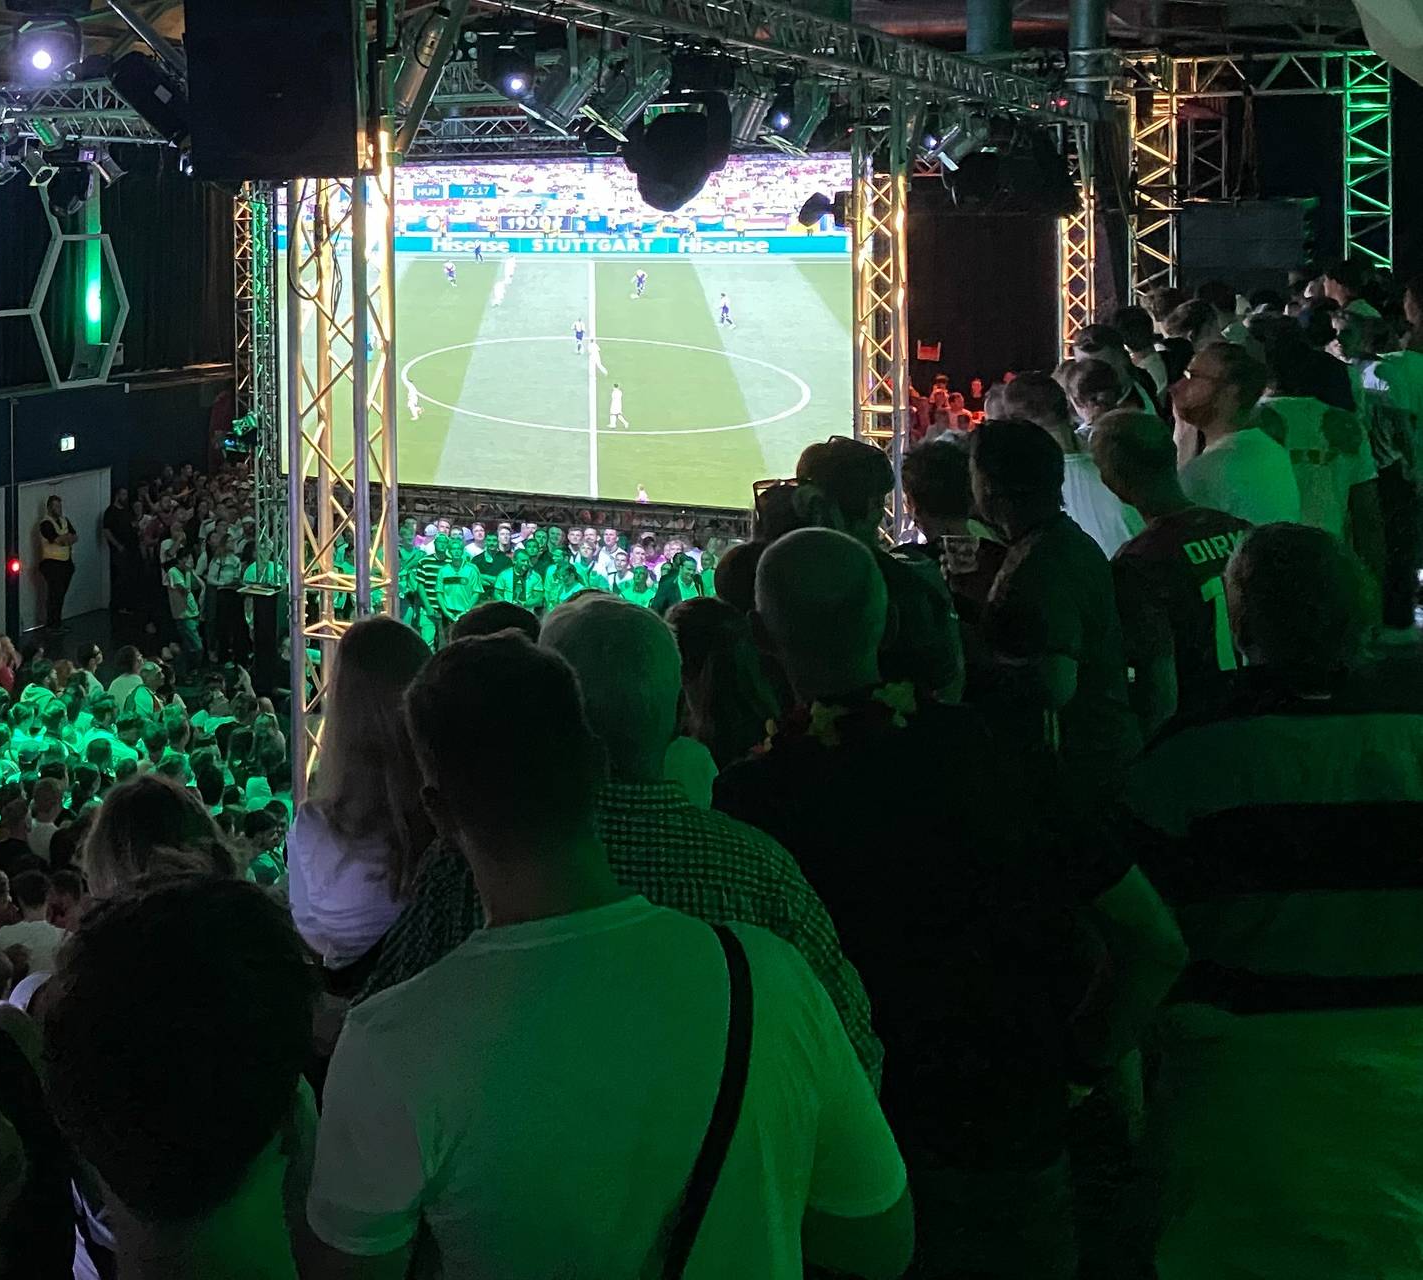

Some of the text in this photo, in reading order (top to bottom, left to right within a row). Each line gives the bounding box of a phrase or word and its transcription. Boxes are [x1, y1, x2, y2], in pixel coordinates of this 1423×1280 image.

[416, 187, 440, 196] HUN
[431, 237, 770, 253] Hisense STUTTGART Hisense
